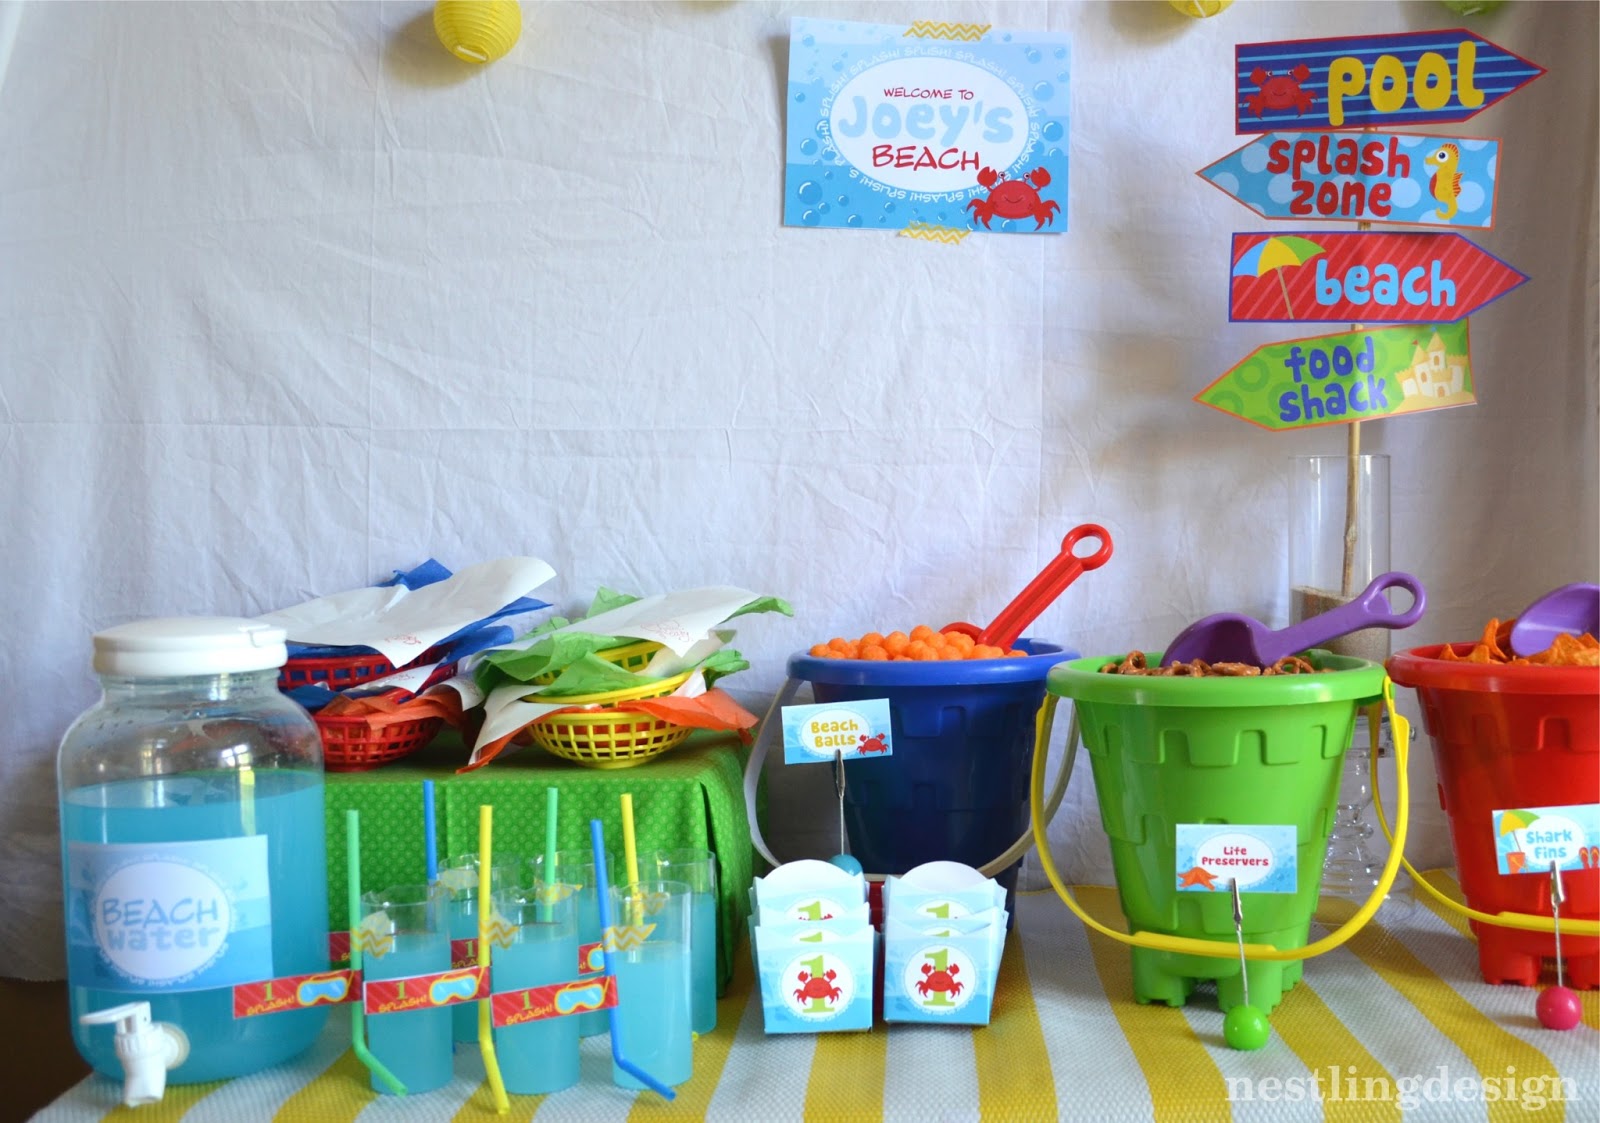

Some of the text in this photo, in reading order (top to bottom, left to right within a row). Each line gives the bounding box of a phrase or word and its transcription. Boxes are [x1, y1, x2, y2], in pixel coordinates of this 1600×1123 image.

[883, 86, 975, 100] WELCOME TO
[1327, 40, 1485, 127] pool
[837, 95, 1014, 148] Joey's
[871, 144, 980, 172] BEACH
[1266, 134, 1411, 181] splash
[1289, 180, 1393, 218] zone
[1315, 258, 1457, 307] beach
[1284, 336, 1376, 384] food
[1278, 374, 1389, 423] shack
[811, 719, 859, 734] Beach
[814, 734, 857, 748] Balls
[1525, 828, 1573, 844] Shark
[1201, 856, 1270, 867] Preservers
[1223, 846, 1248, 856] Life
[1534, 846, 1568, 859] Fins
[102, 897, 220, 929] BEACH
[106, 925, 221, 953] water
[263, 981, 276, 1002] 1
[395, 980, 408, 1001] 1
[520, 990, 533, 1011] 1
[246, 994, 295, 1016] SPLASH!
[378, 993, 428, 1014] SPLASH!
[505, 1002, 554, 1026] SPLASH!
